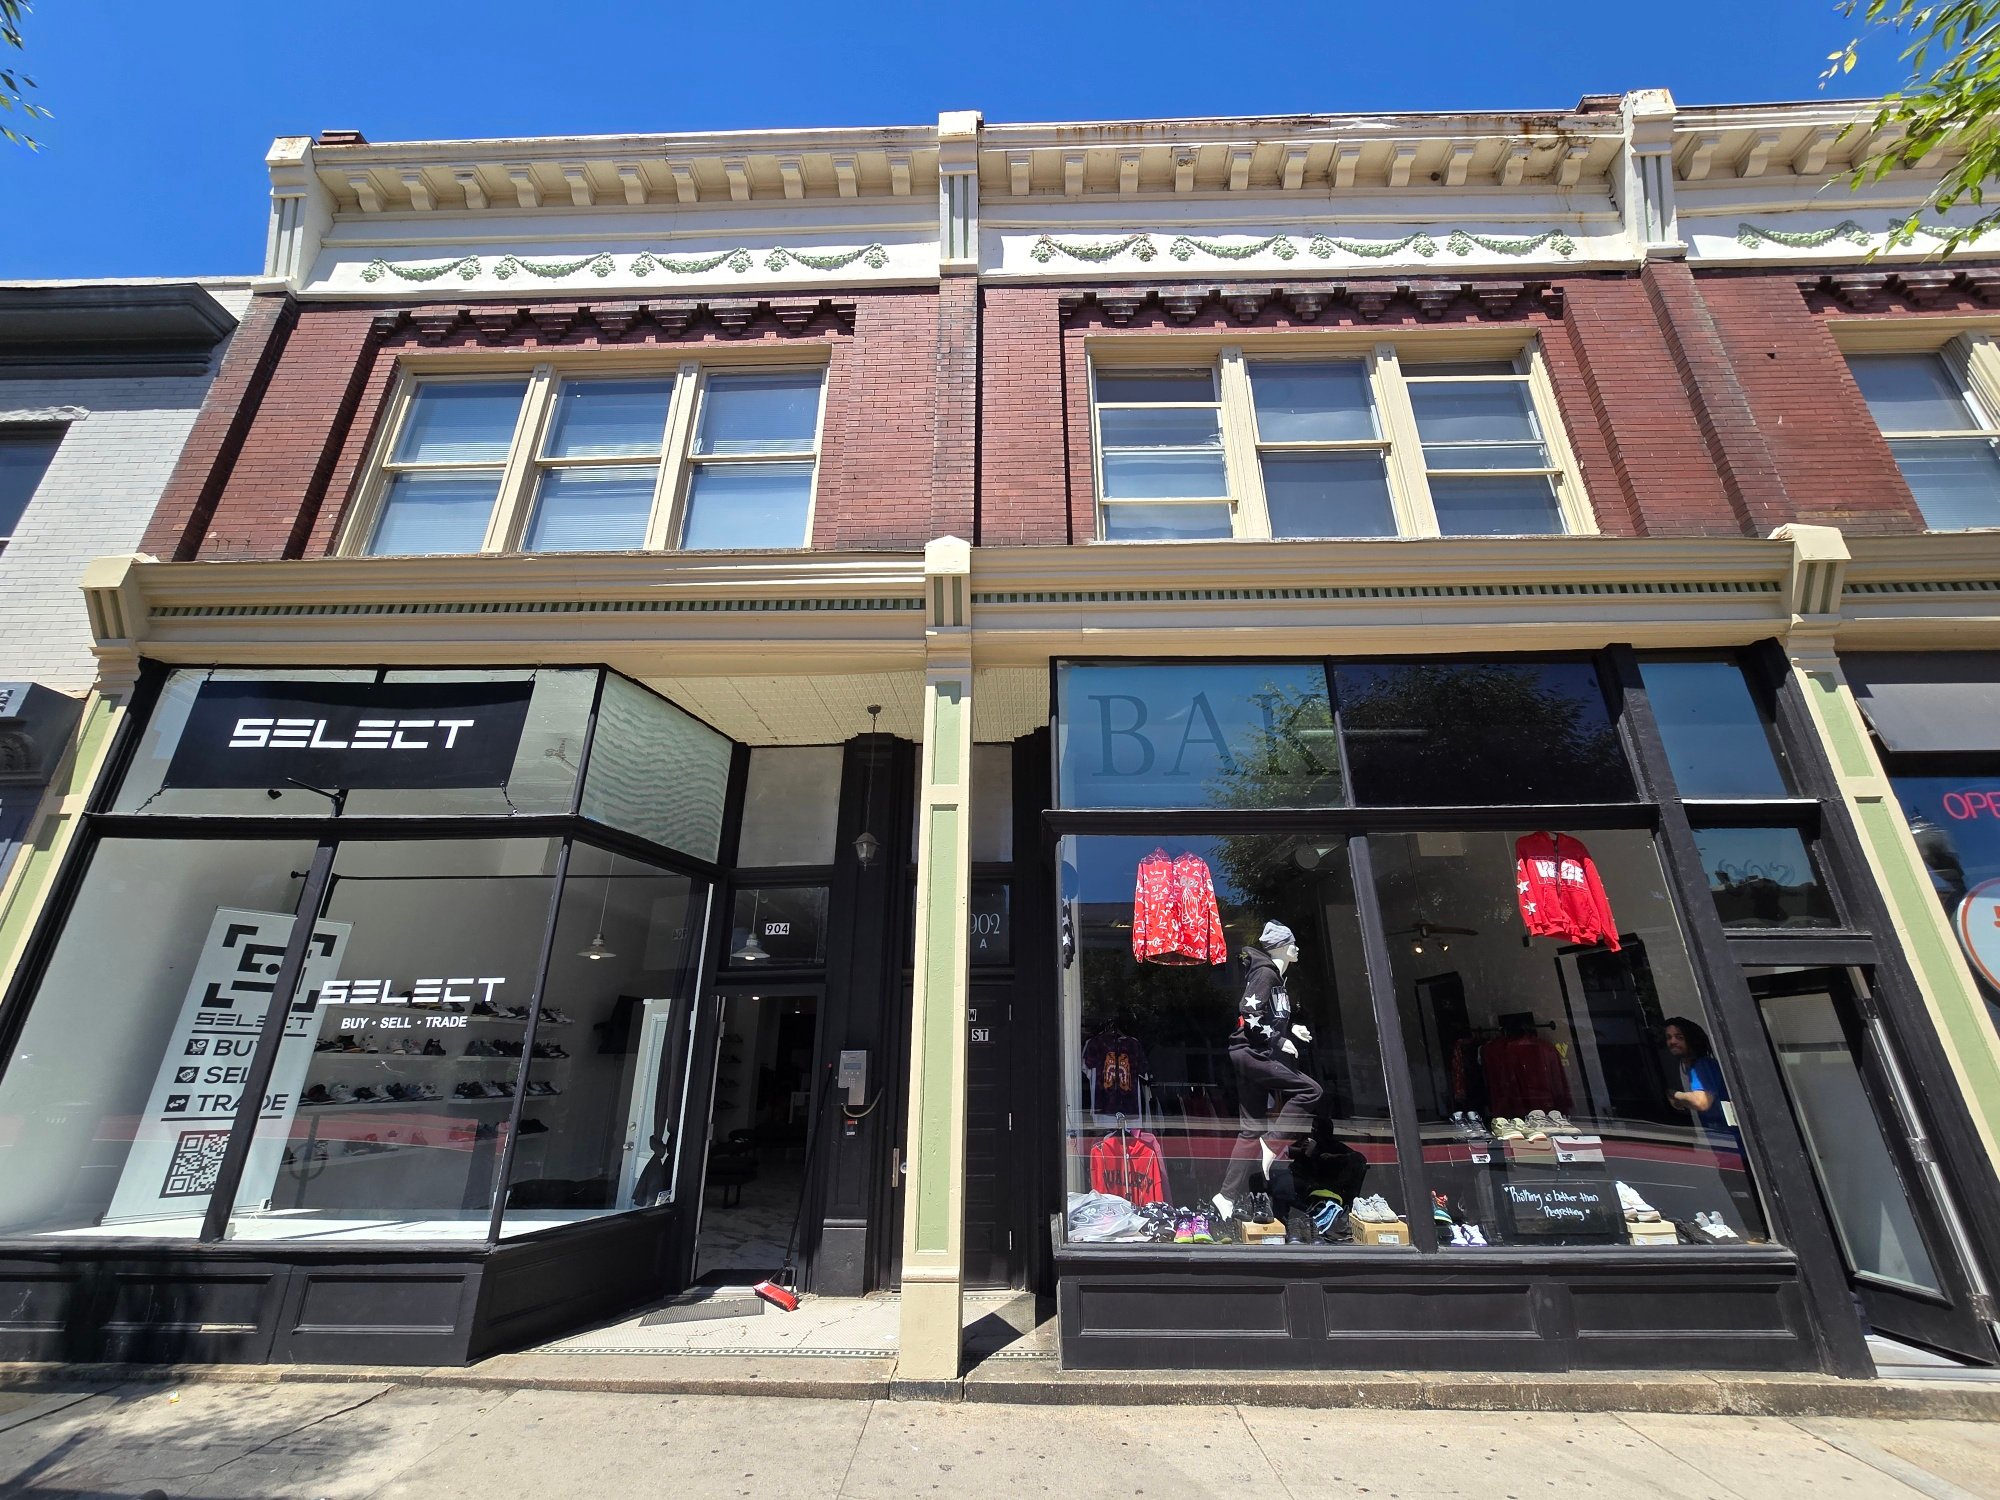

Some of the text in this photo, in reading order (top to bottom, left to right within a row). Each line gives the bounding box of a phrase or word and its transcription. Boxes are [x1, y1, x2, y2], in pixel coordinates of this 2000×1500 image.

[228, 718, 475, 748] SELECT
[767, 924, 788, 934] 904
[979, 938, 987, 948] A
[318, 977, 505, 1004] SELECT
[194, 1012, 312, 1029] SELET
[341, 1016, 468, 1029] BUY SELL TRADE
[973, 1029, 988, 1041] ST
[213, 1039, 260, 1056] BU
[204, 1066, 248, 1084] SEL
[1544, 1193, 1552, 1201] is
[1552, 1189, 1577, 1202] better
[1580, 1192, 1599, 1202] than
